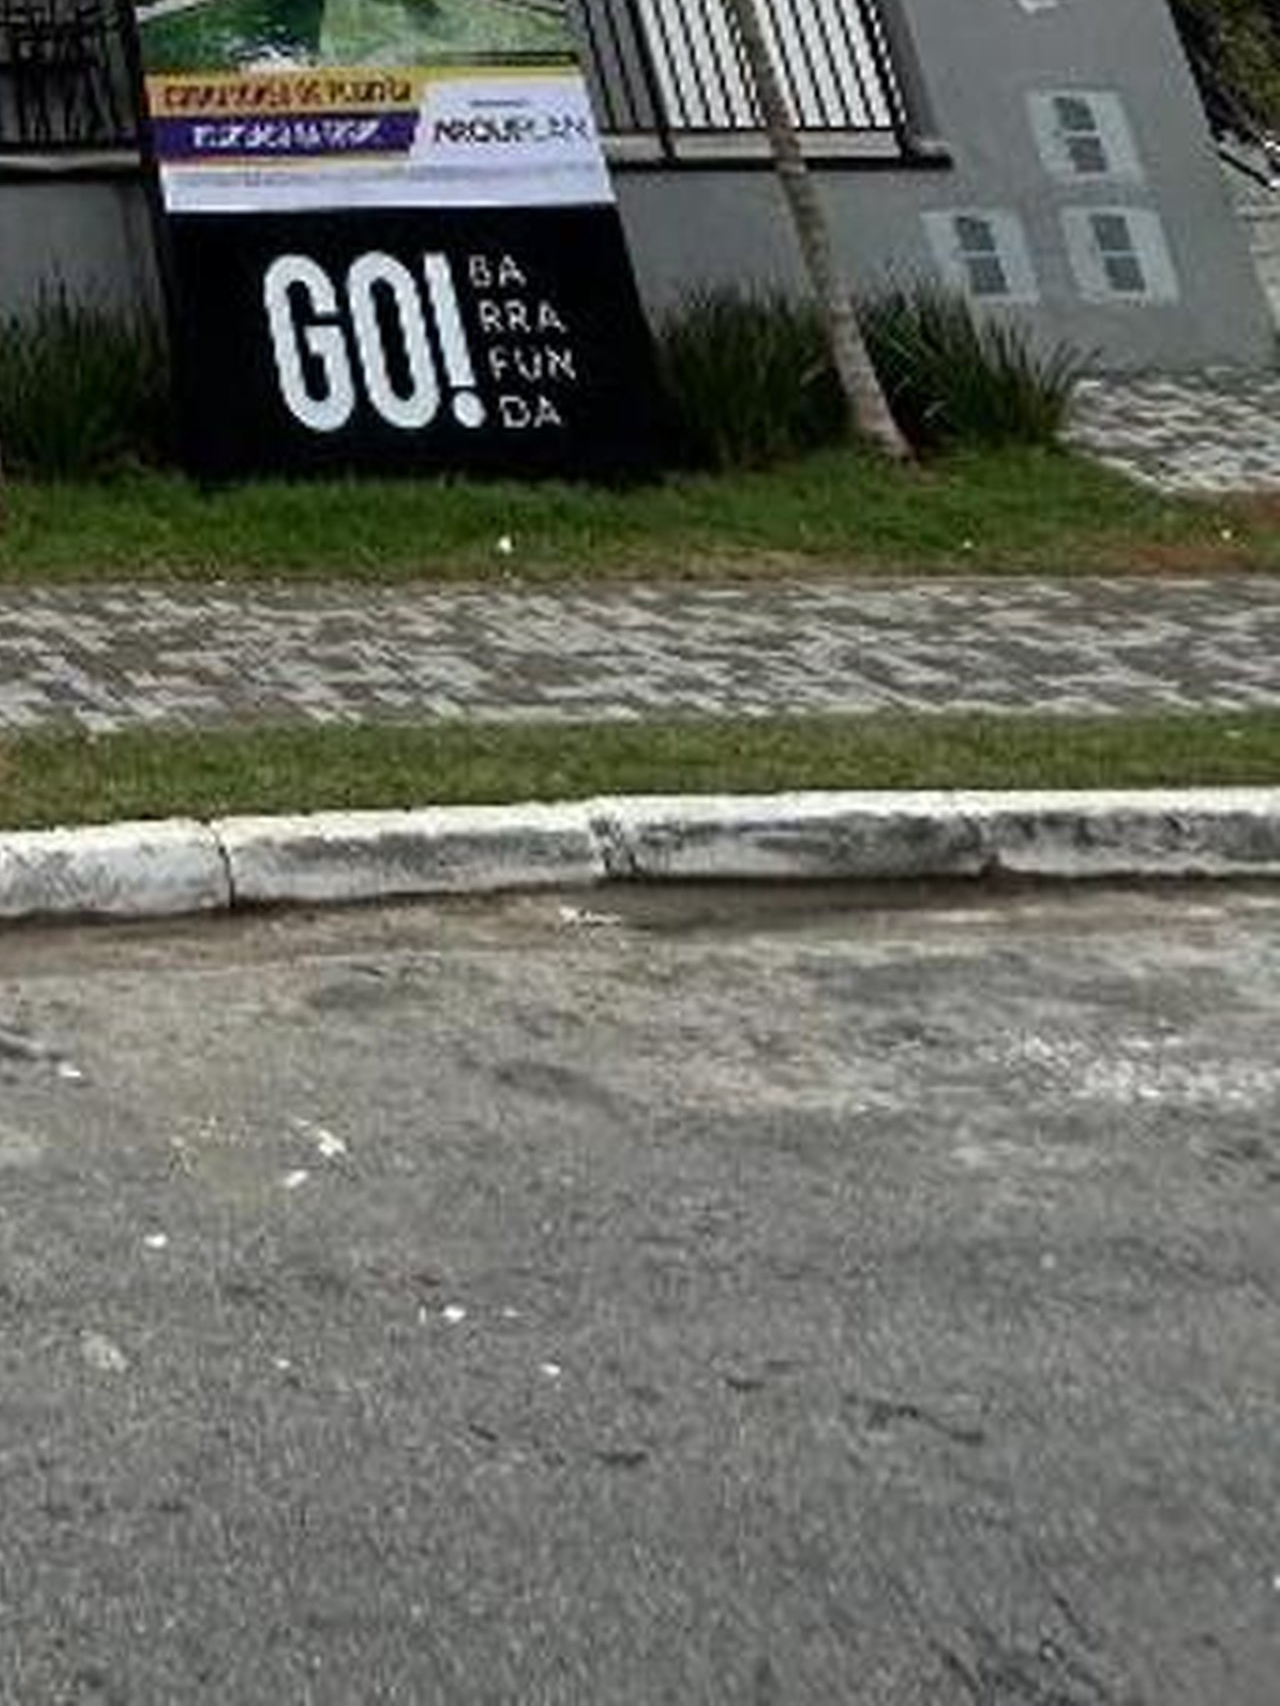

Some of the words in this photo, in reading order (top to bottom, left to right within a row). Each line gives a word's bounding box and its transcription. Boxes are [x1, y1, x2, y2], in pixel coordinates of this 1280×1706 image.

[469, 254, 527, 288] BA
[478, 300, 567, 333] RRA
[263, 251, 487, 431] GO!
[489, 346, 577, 382] FUN
[498, 394, 562, 428] DA
